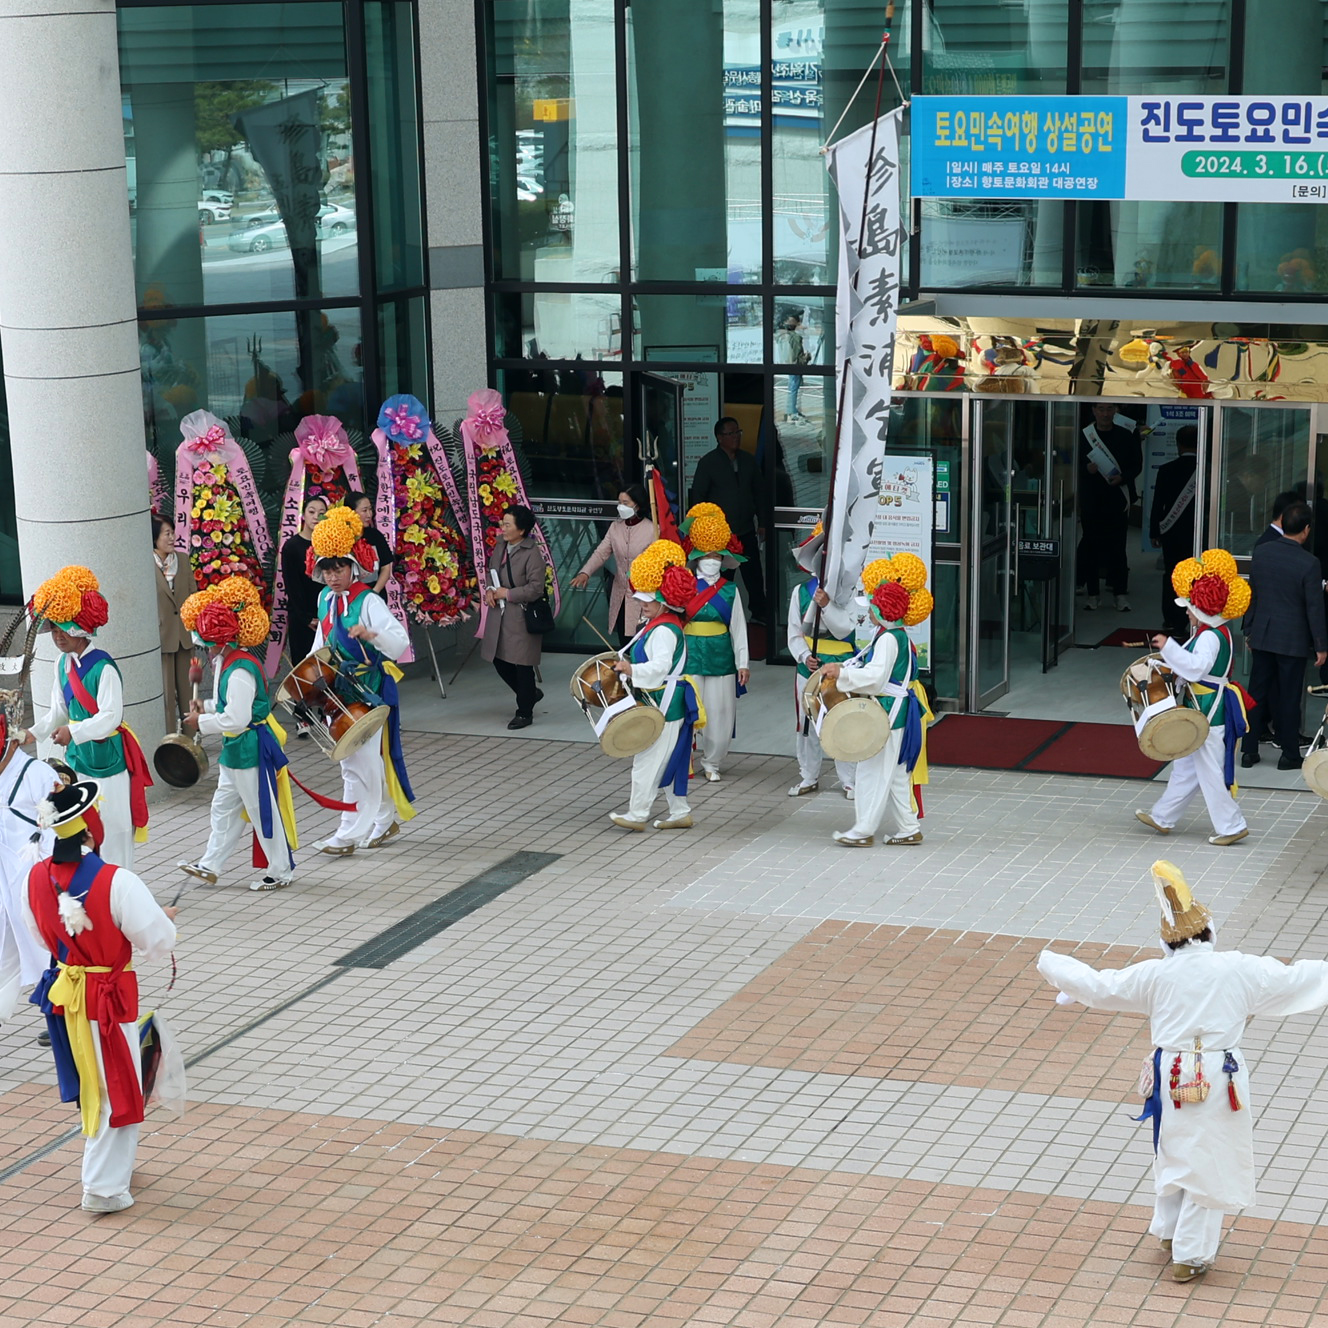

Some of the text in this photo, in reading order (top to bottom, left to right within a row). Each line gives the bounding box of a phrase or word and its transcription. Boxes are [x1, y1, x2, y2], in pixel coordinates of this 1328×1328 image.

[934, 110, 1113, 154] 토요민속여행 상설공연
[982, 161, 1004, 174] 매주
[1007, 162, 1041, 174] 토요일
[1045, 162, 1070, 174] 14시
[1194, 154, 1248, 175] 2024.
[1255, 154, 1274, 175] 3.
[982, 176, 1049, 189] 향토문화회관
[1052, 177, 1099, 190] 대공연장
[1292, 185, 1327, 199] [문의]
[878, 495, 902, 507] OP 5
